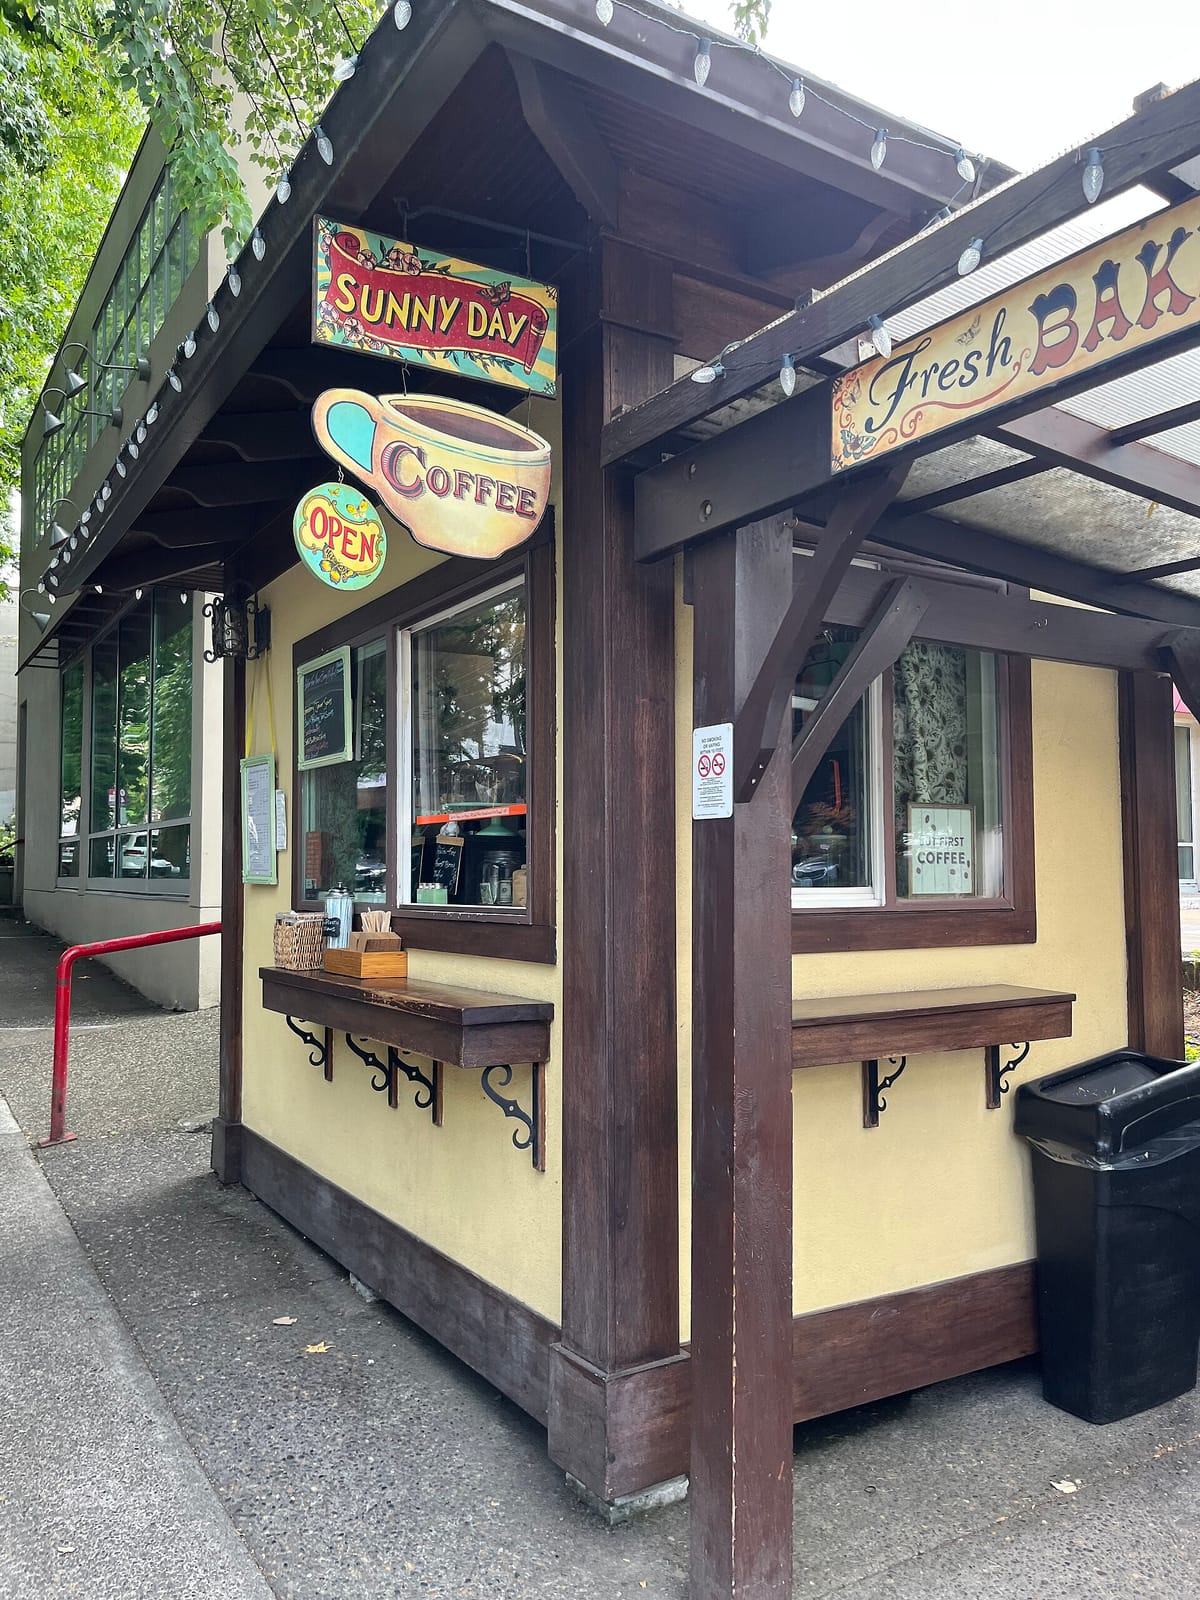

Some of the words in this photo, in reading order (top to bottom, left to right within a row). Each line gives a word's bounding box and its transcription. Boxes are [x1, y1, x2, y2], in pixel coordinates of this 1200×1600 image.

[334, 272, 462, 333] SUNNY
[466, 300, 529, 346] DAY
[864, 307, 1014, 434] Fresh
[1027, 226, 1200, 376] BAK
[380, 439, 537, 520] COFFEE
[310, 506, 376, 563] OPEN
[917, 851, 966, 865] COFFEE
[939, 836, 965, 848] FIRST
